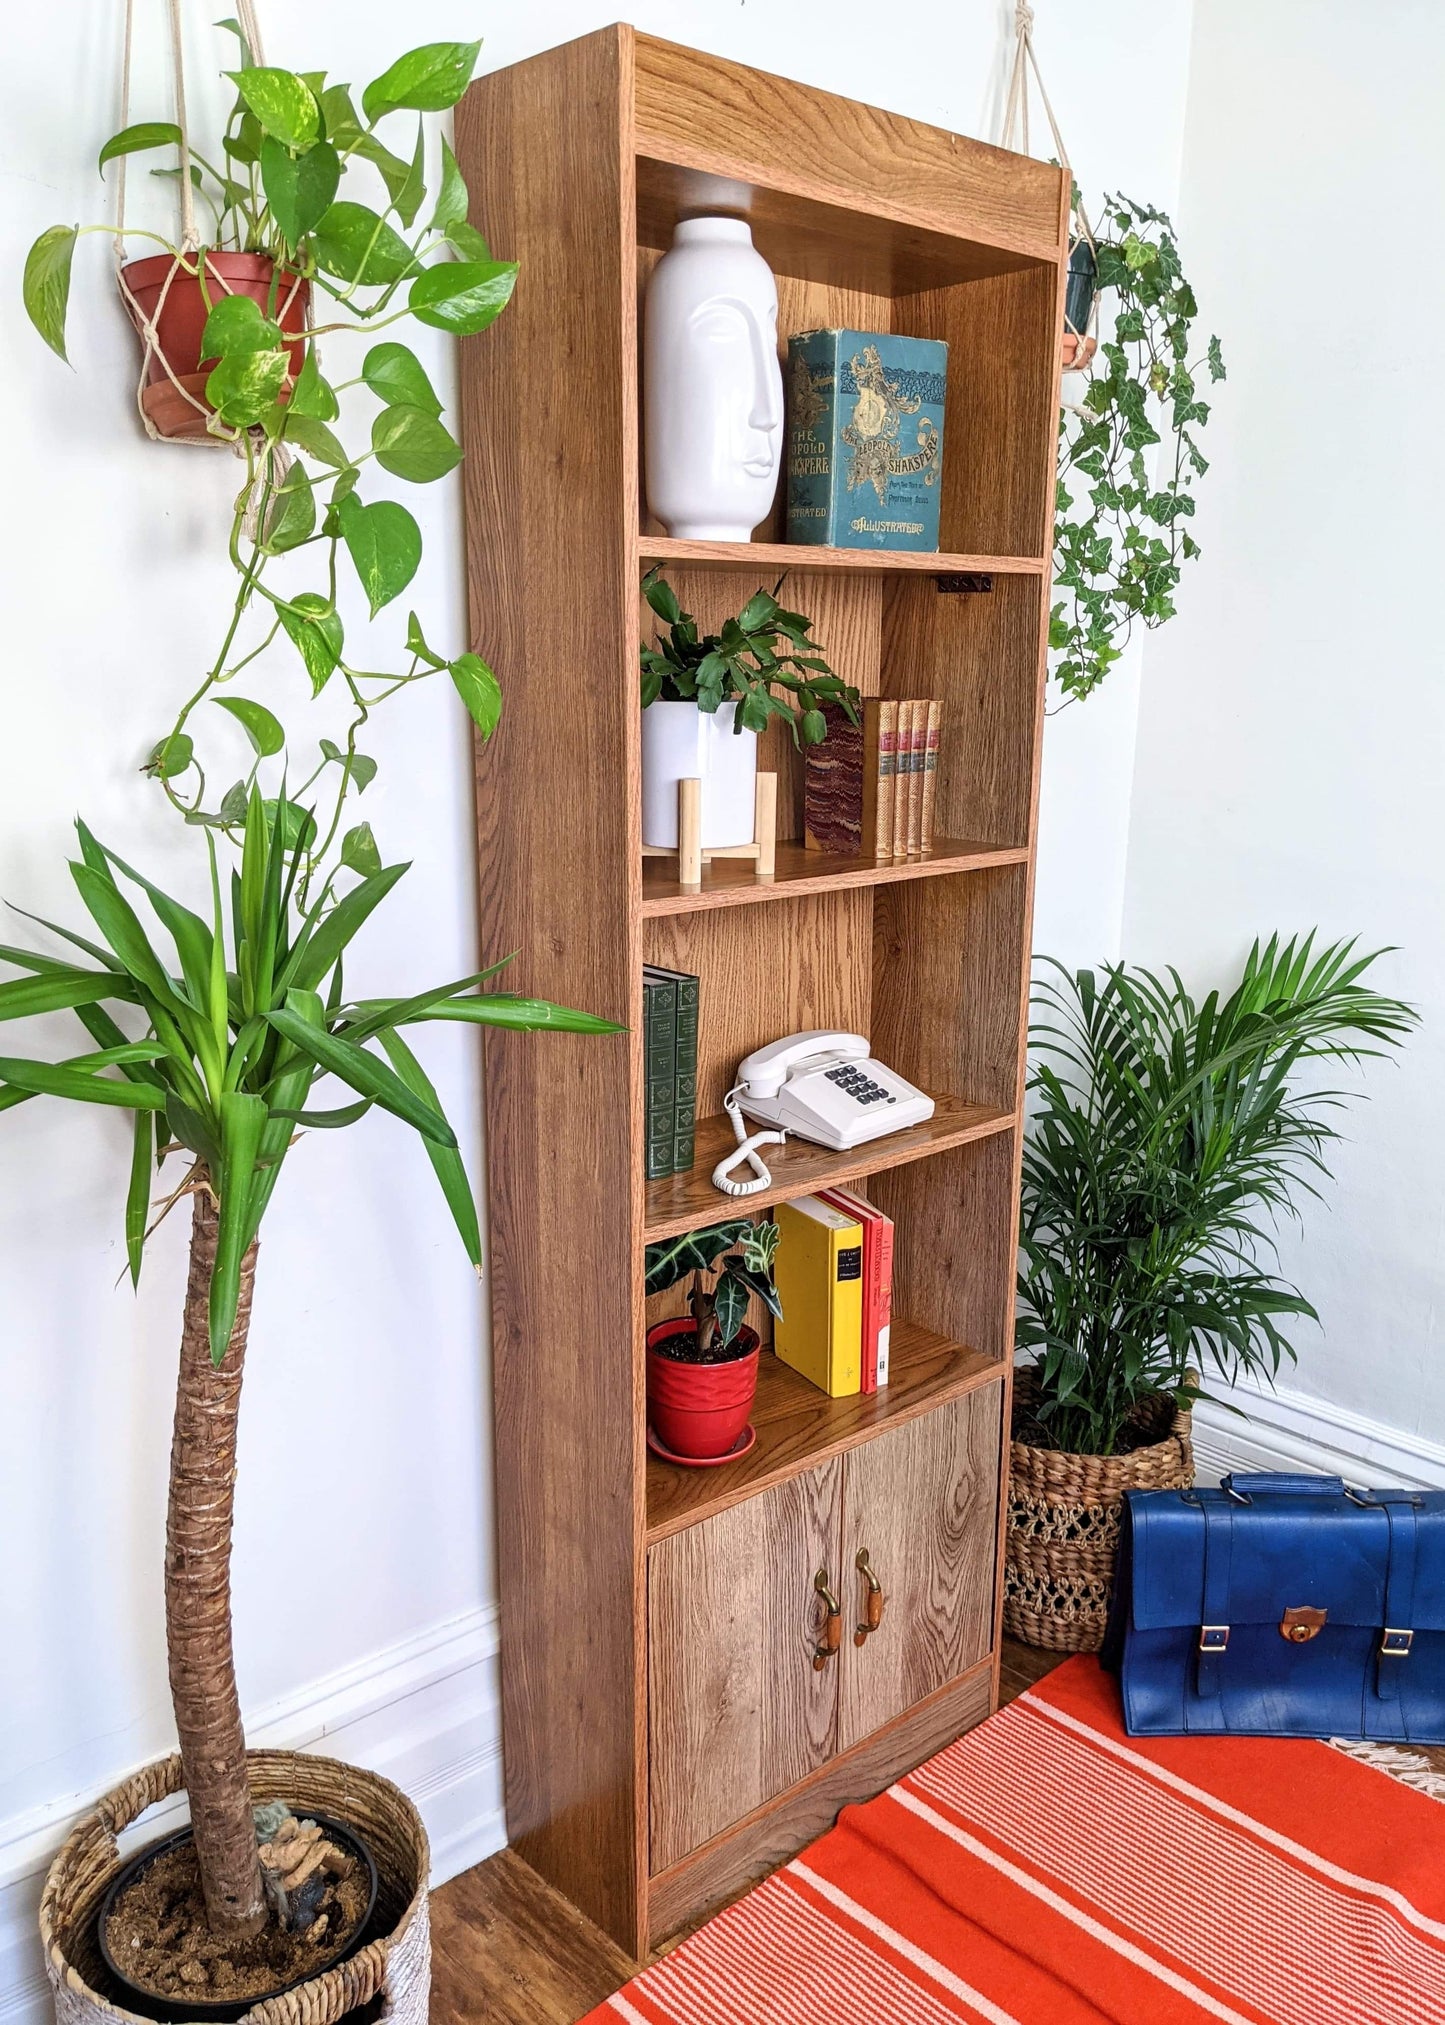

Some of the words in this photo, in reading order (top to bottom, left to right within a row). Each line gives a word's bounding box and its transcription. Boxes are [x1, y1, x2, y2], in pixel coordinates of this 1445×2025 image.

[791, 442, 825, 455] OPOLD
[888, 434, 938, 473] SHAKSPERE
[791, 457, 829, 476] AKSPERE
[791, 507, 827, 518] STRATED
